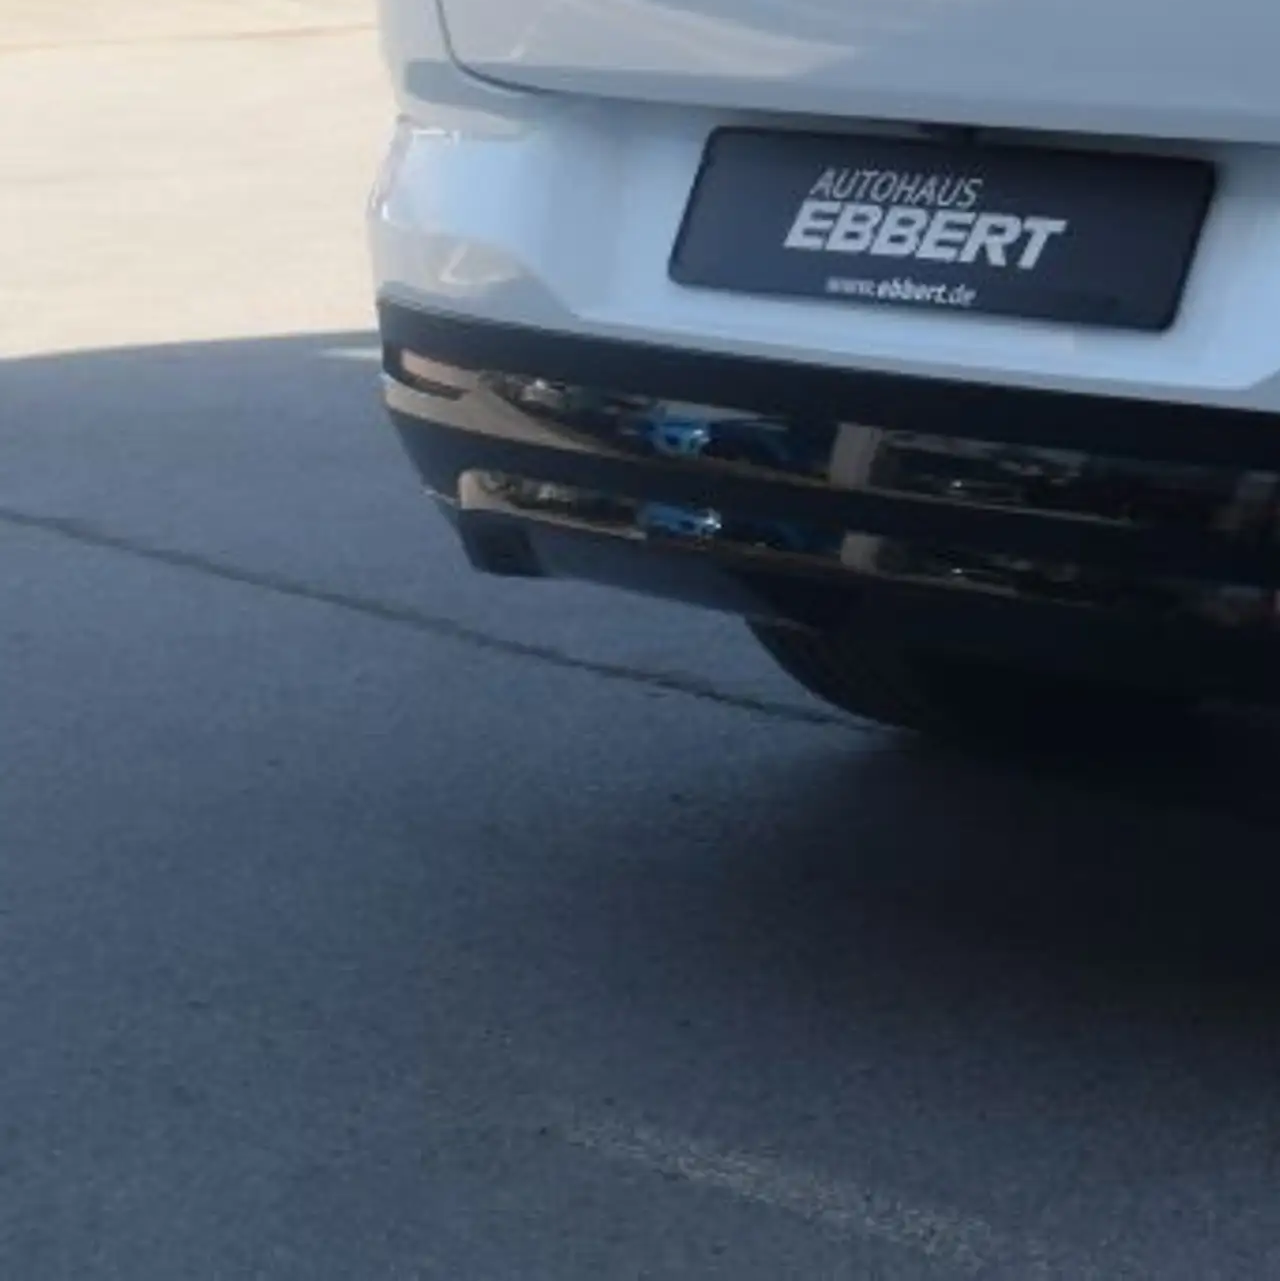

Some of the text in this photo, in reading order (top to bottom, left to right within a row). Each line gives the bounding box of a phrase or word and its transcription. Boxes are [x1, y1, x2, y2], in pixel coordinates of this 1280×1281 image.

[808, 167, 984, 209] AUTOHAUS
[783, 199, 1069, 271] EBBERT
[825, 276, 978, 306] www.ebbert.de
